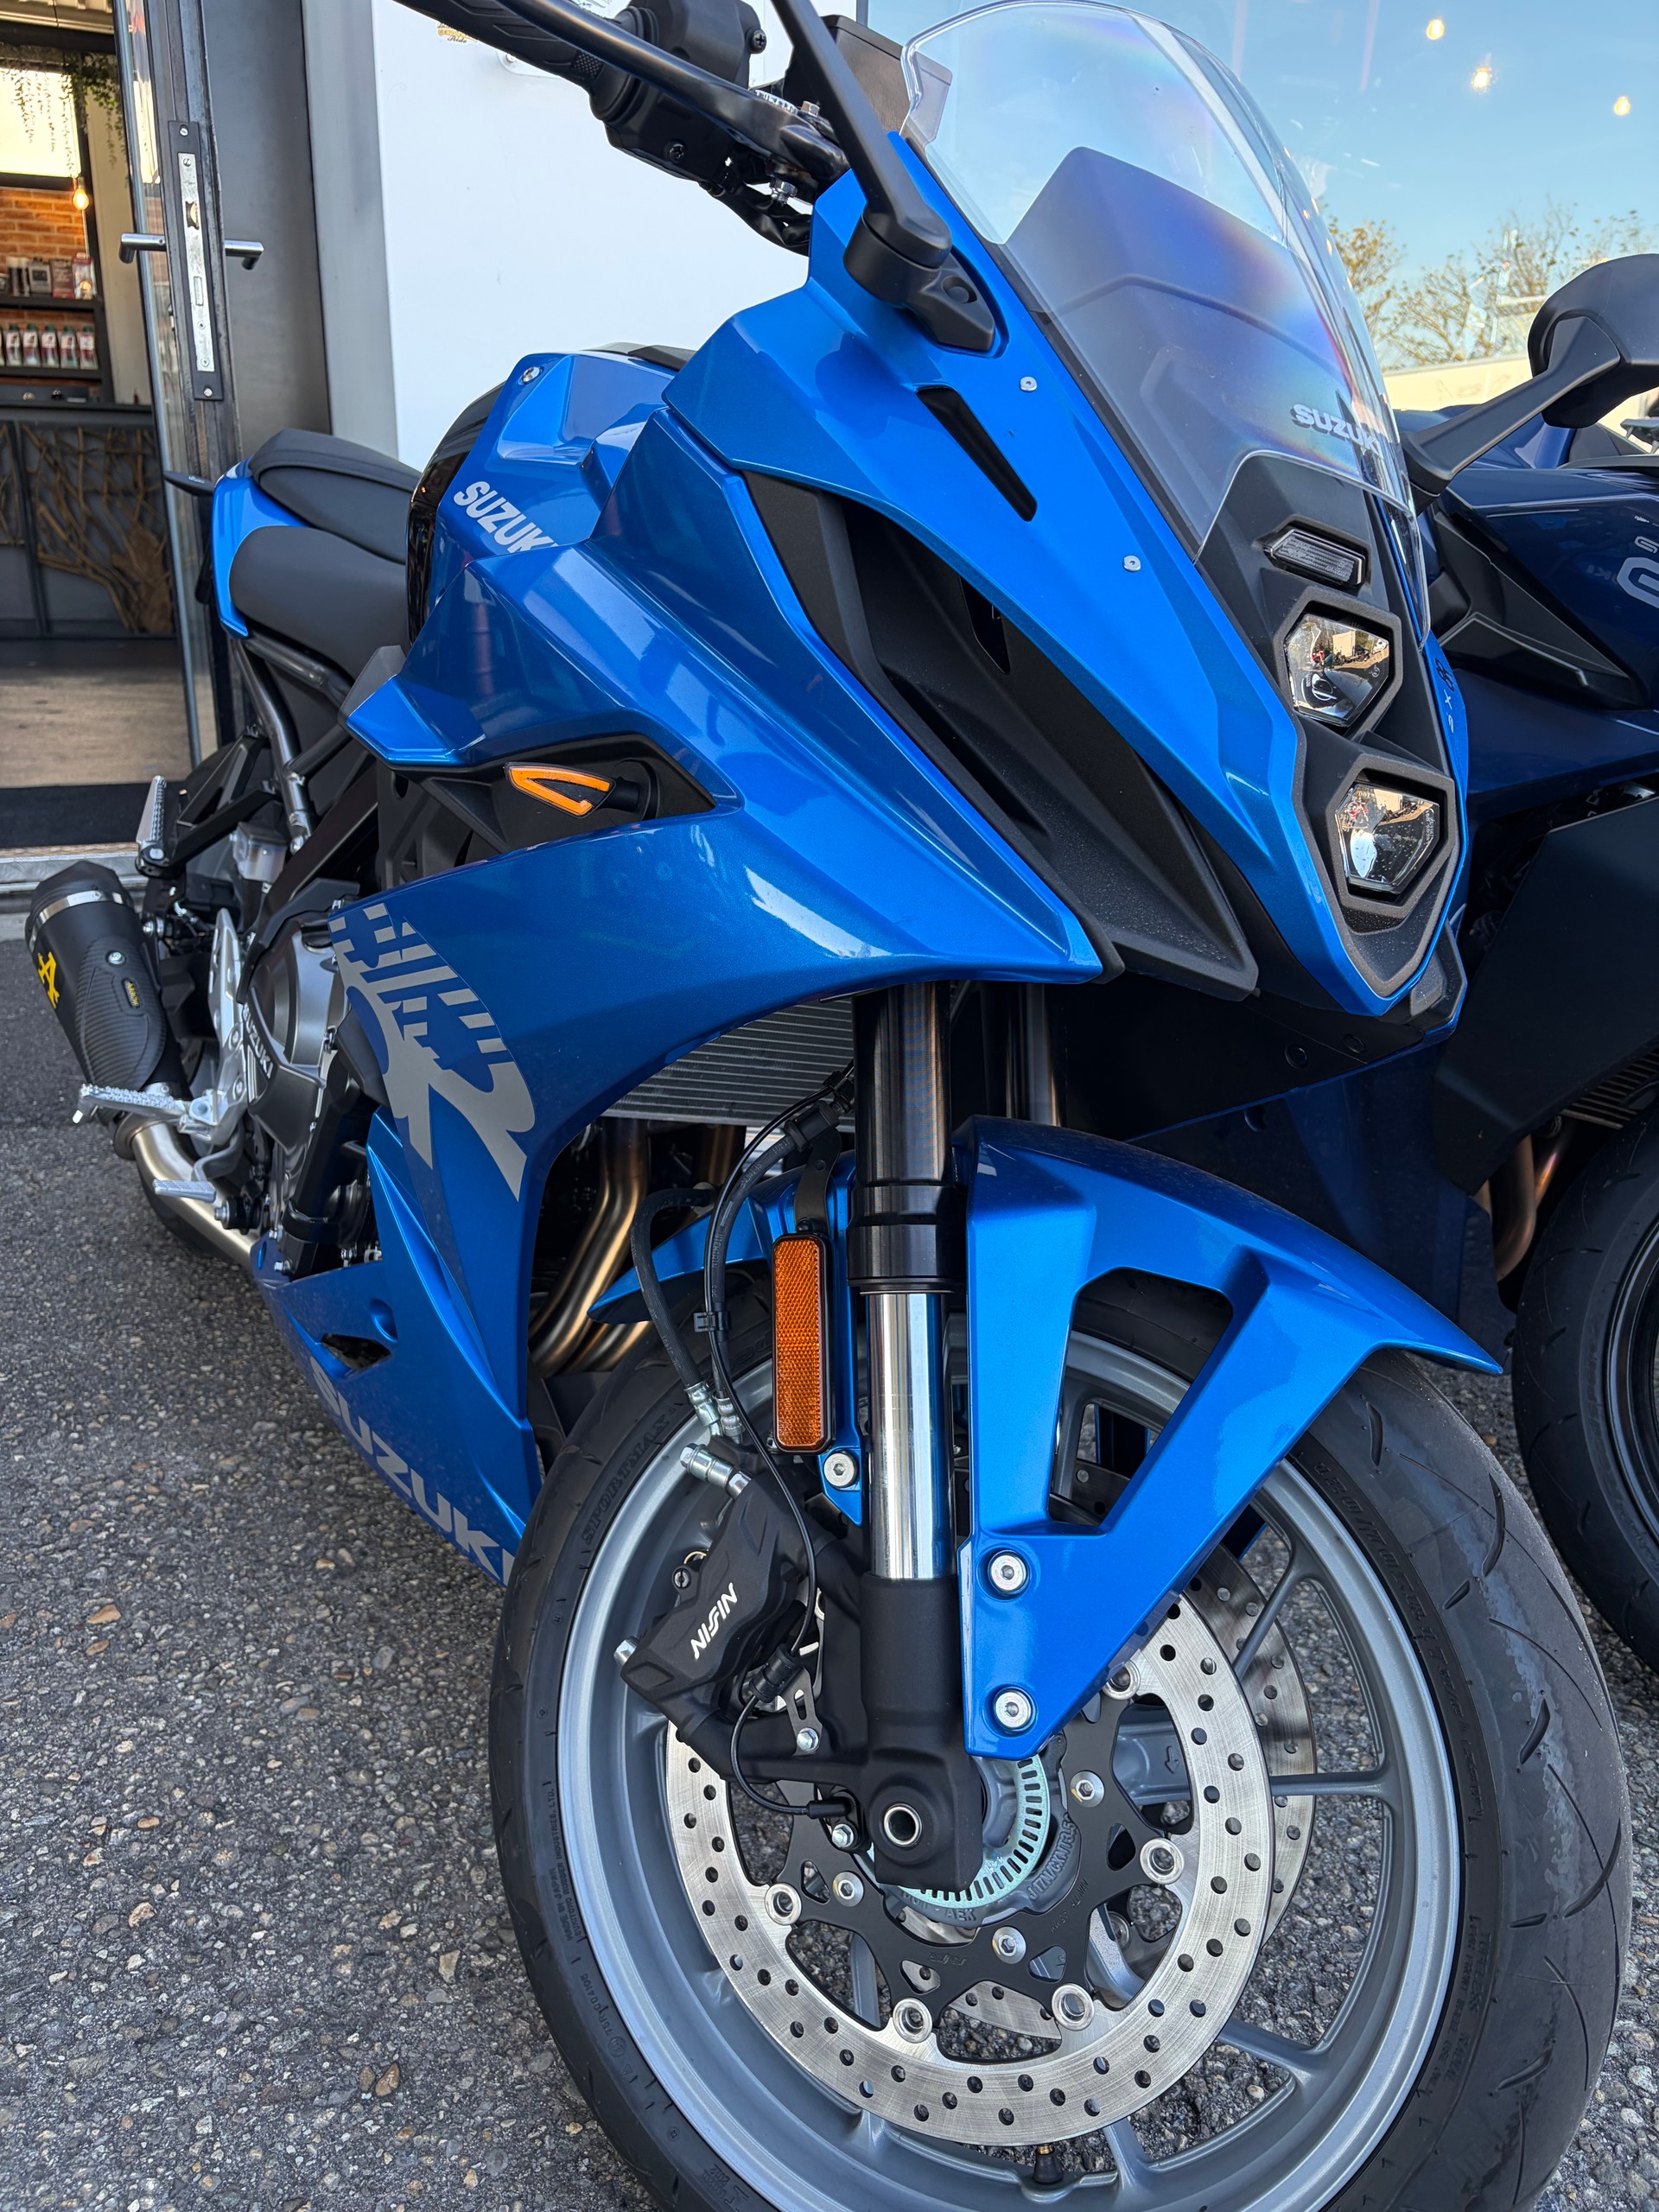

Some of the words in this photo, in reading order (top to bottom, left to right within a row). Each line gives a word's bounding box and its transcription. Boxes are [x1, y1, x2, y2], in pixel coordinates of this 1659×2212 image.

[453, 480, 559, 555] SUZUK
[243, 1002, 274, 1079] SUZUKI
[310, 1356, 515, 1587] SUZUKI
[582, 1414, 670, 1546] SPORTMAX
[690, 1582, 737, 1660] NISSIN
[549, 1866, 562, 1900] JAPAN
[557, 1861, 570, 1895] RUBBER
